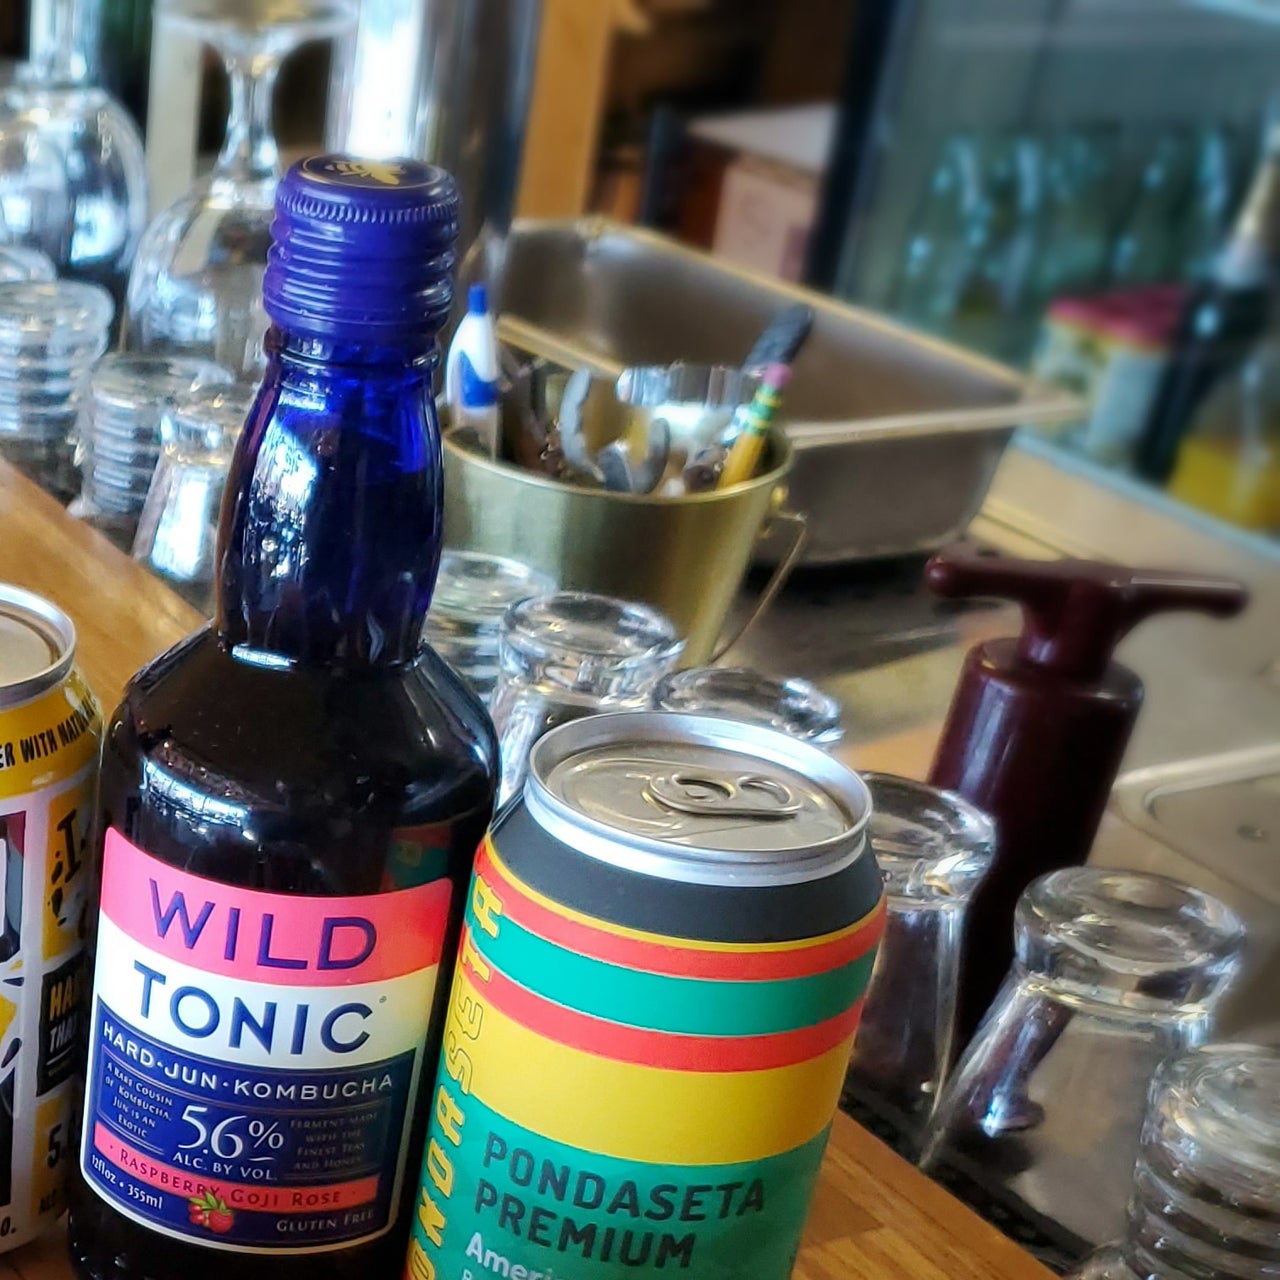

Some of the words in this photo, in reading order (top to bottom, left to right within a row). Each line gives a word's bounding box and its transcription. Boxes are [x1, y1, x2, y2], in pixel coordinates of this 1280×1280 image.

[20, 728, 58, 763] WITH
[148, 878, 377, 971] WILD
[133, 960, 374, 1055] TONIC
[114, 1067, 133, 1087] RARE
[135, 1082, 173, 1106] COUSIN
[113, 1096, 128, 1113] JUN
[131, 1109, 139, 1120] IS
[142, 1116, 156, 1128] AN
[118, 1114, 147, 1138] EXOTIC
[177, 1104, 284, 1160] 5.6%
[213, 1162, 233, 1175] BY
[483, 1131, 765, 1222] PONDASETA
[127, 1184, 163, 1209] 355ml
[231, 1189, 279, 1208] GOJI
[292, 1191, 340, 1206] ROSE
[474, 1178, 696, 1269] PREMIUM
